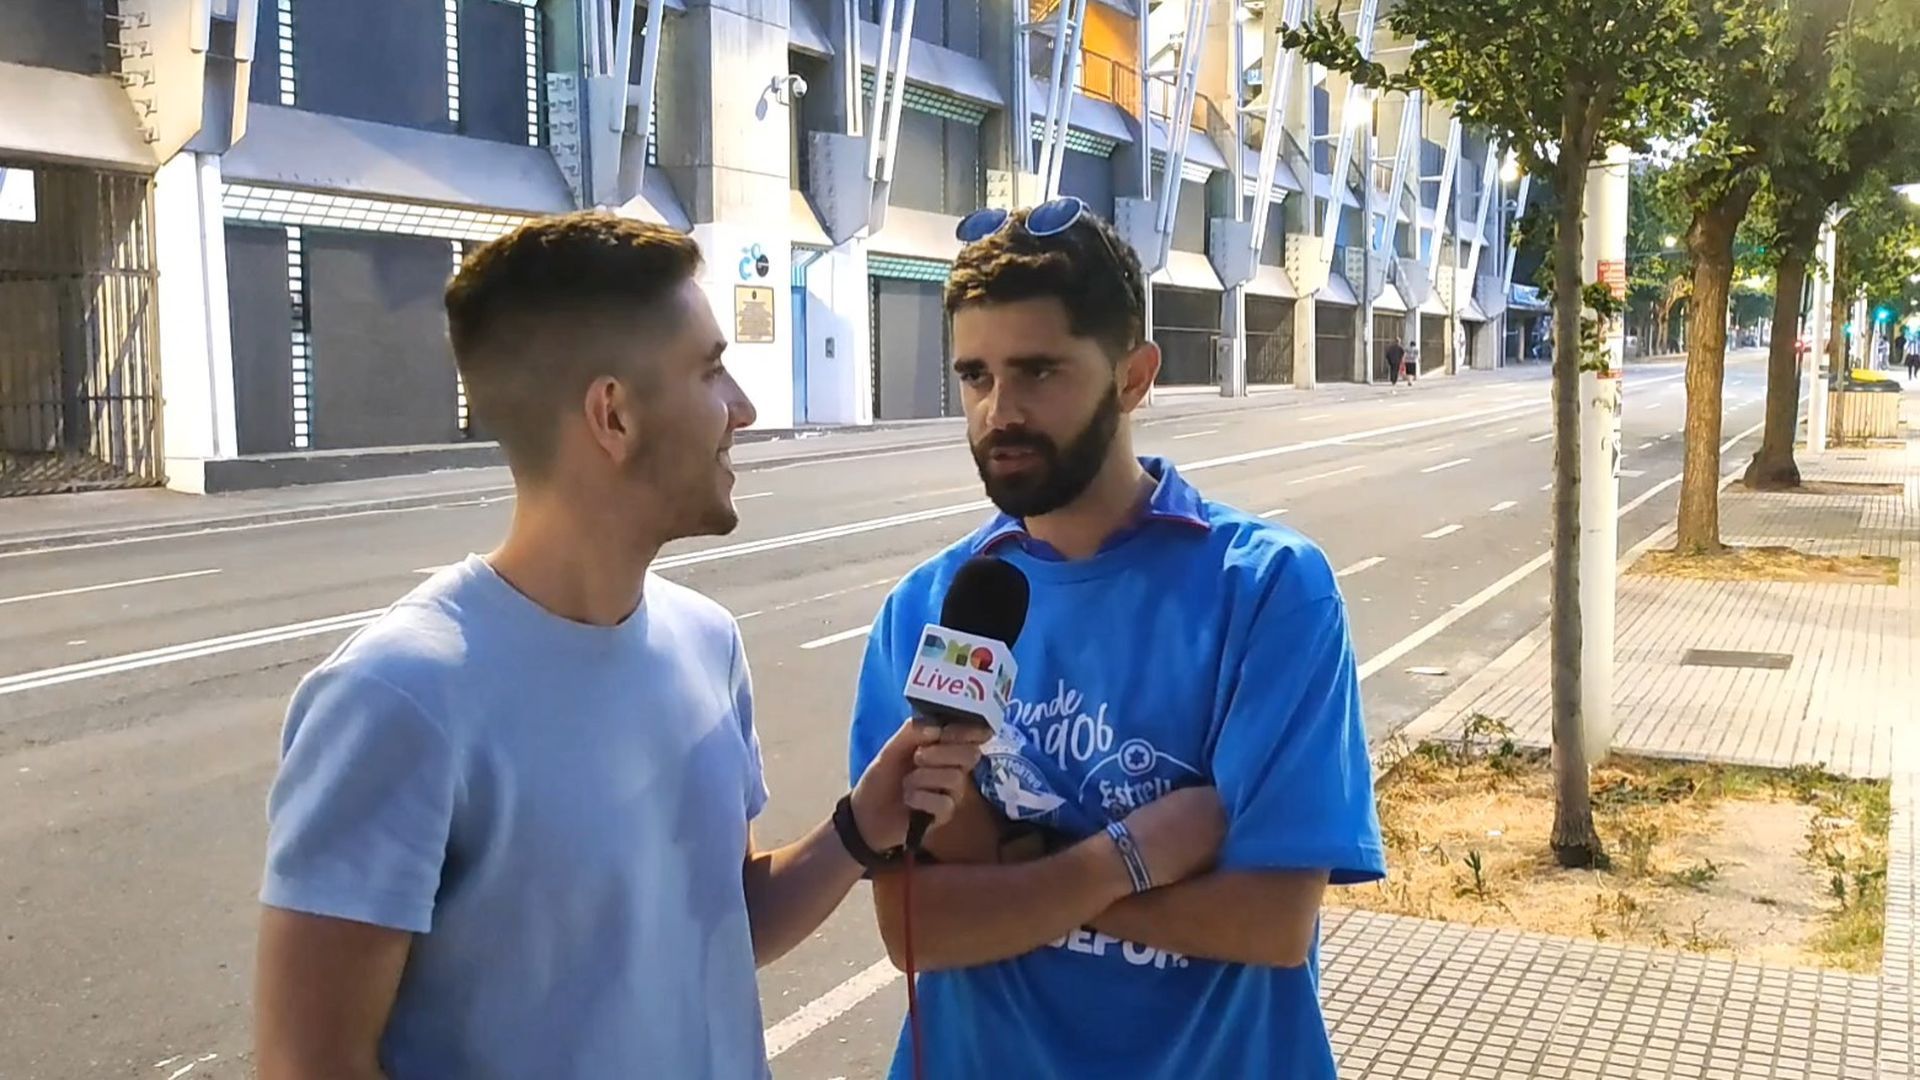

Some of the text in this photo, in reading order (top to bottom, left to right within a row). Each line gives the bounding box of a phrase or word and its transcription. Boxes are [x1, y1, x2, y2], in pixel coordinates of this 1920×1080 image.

[912, 665, 964, 695] Live
[1005, 678, 1084, 726] Dende
[1028, 702, 1114, 771] 1906
